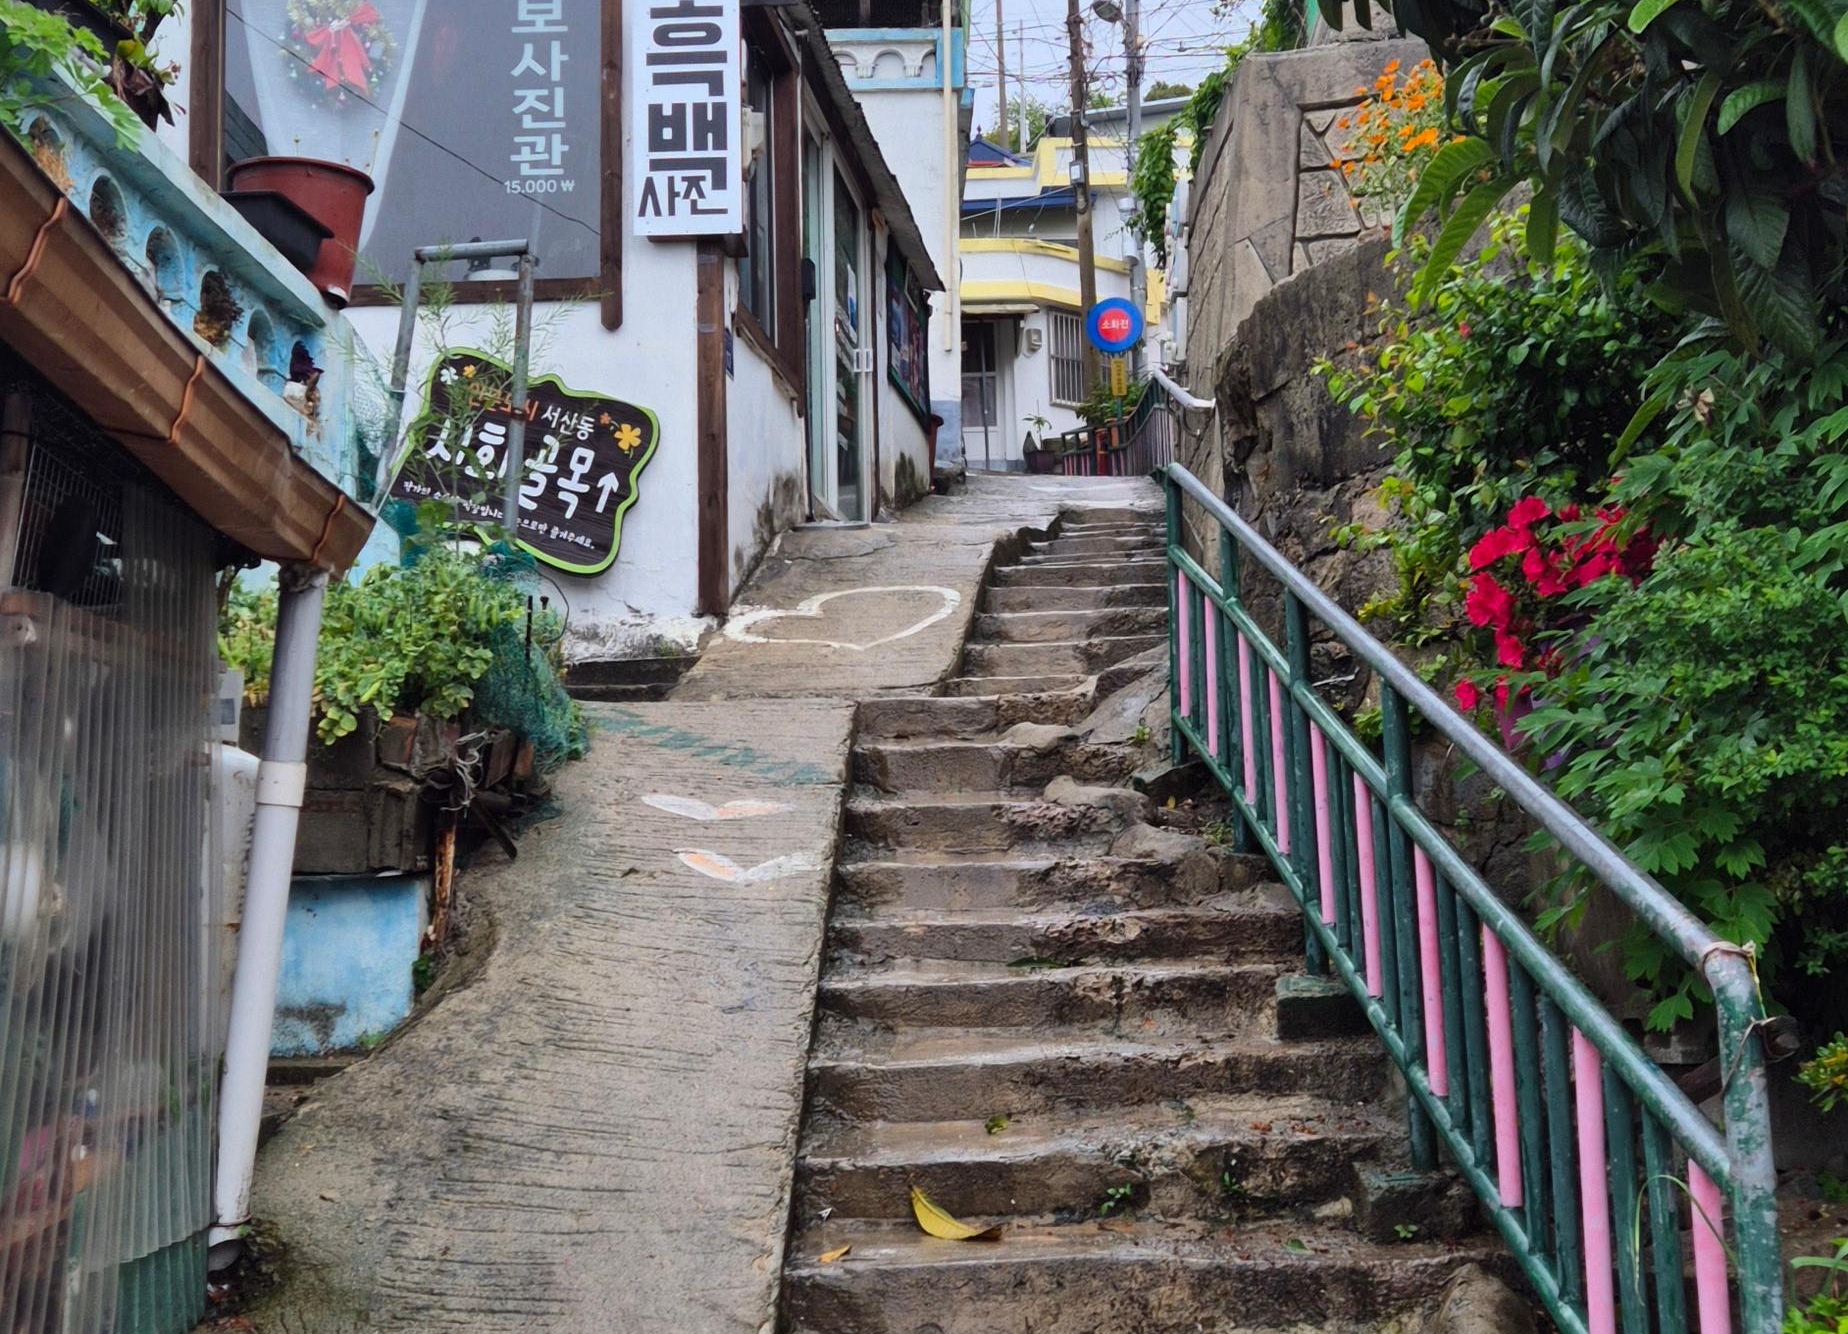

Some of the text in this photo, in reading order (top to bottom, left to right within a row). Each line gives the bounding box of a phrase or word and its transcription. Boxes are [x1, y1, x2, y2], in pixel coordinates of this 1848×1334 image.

[646, 0, 728, 190] 흑백
[503, 179, 557, 194] 15.000
[638, 175, 728, 217] 사진
[1101, 318, 1129, 330] 소화전
[541, 404, 595, 440] 서산동
